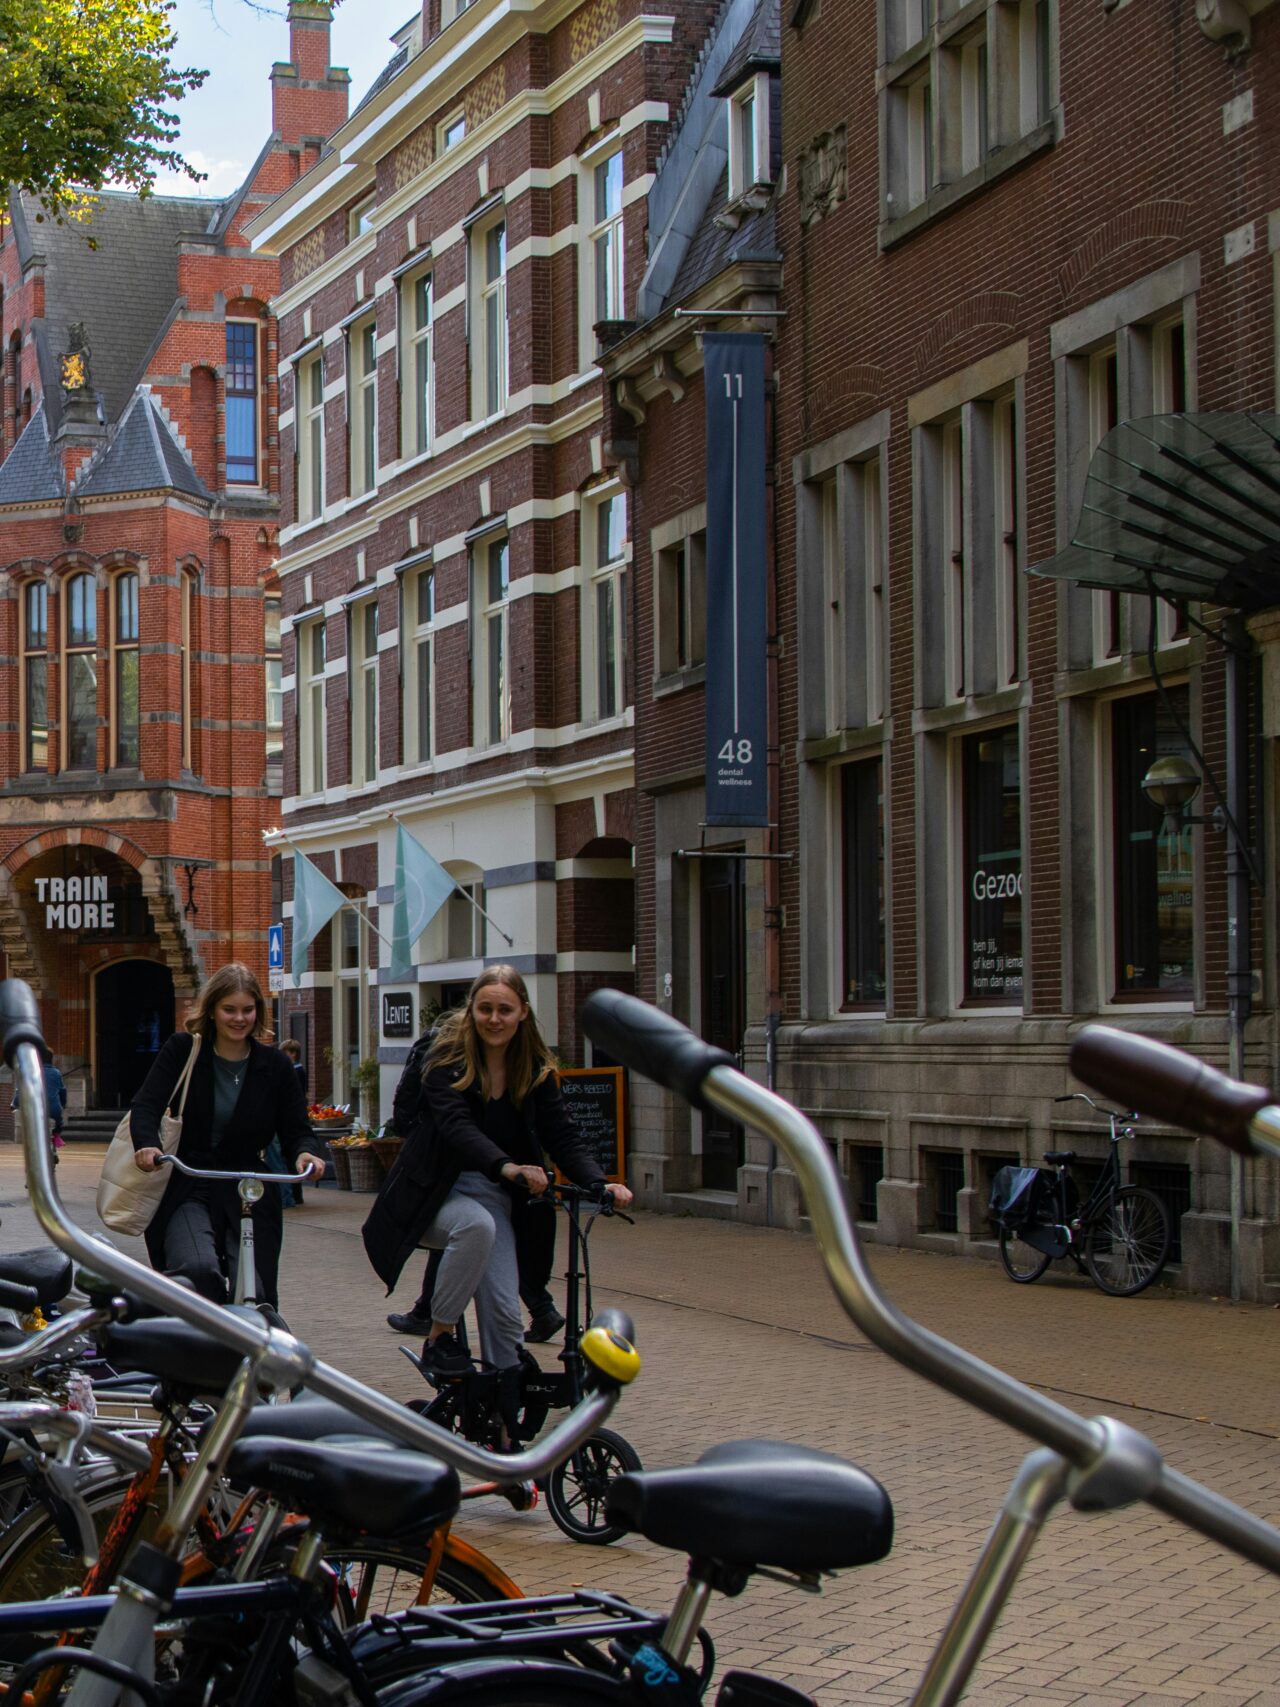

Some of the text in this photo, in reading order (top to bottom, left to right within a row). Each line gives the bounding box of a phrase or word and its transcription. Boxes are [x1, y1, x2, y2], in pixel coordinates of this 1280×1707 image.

[723, 373, 742, 398] 11
[717, 738, 753, 764] 48
[718, 768, 744, 776] dental
[718, 777, 753, 786] wellness
[34, 875, 108, 903] TRAIN
[46, 903, 115, 930] MORE
[384, 996, 410, 1024] LENTE
